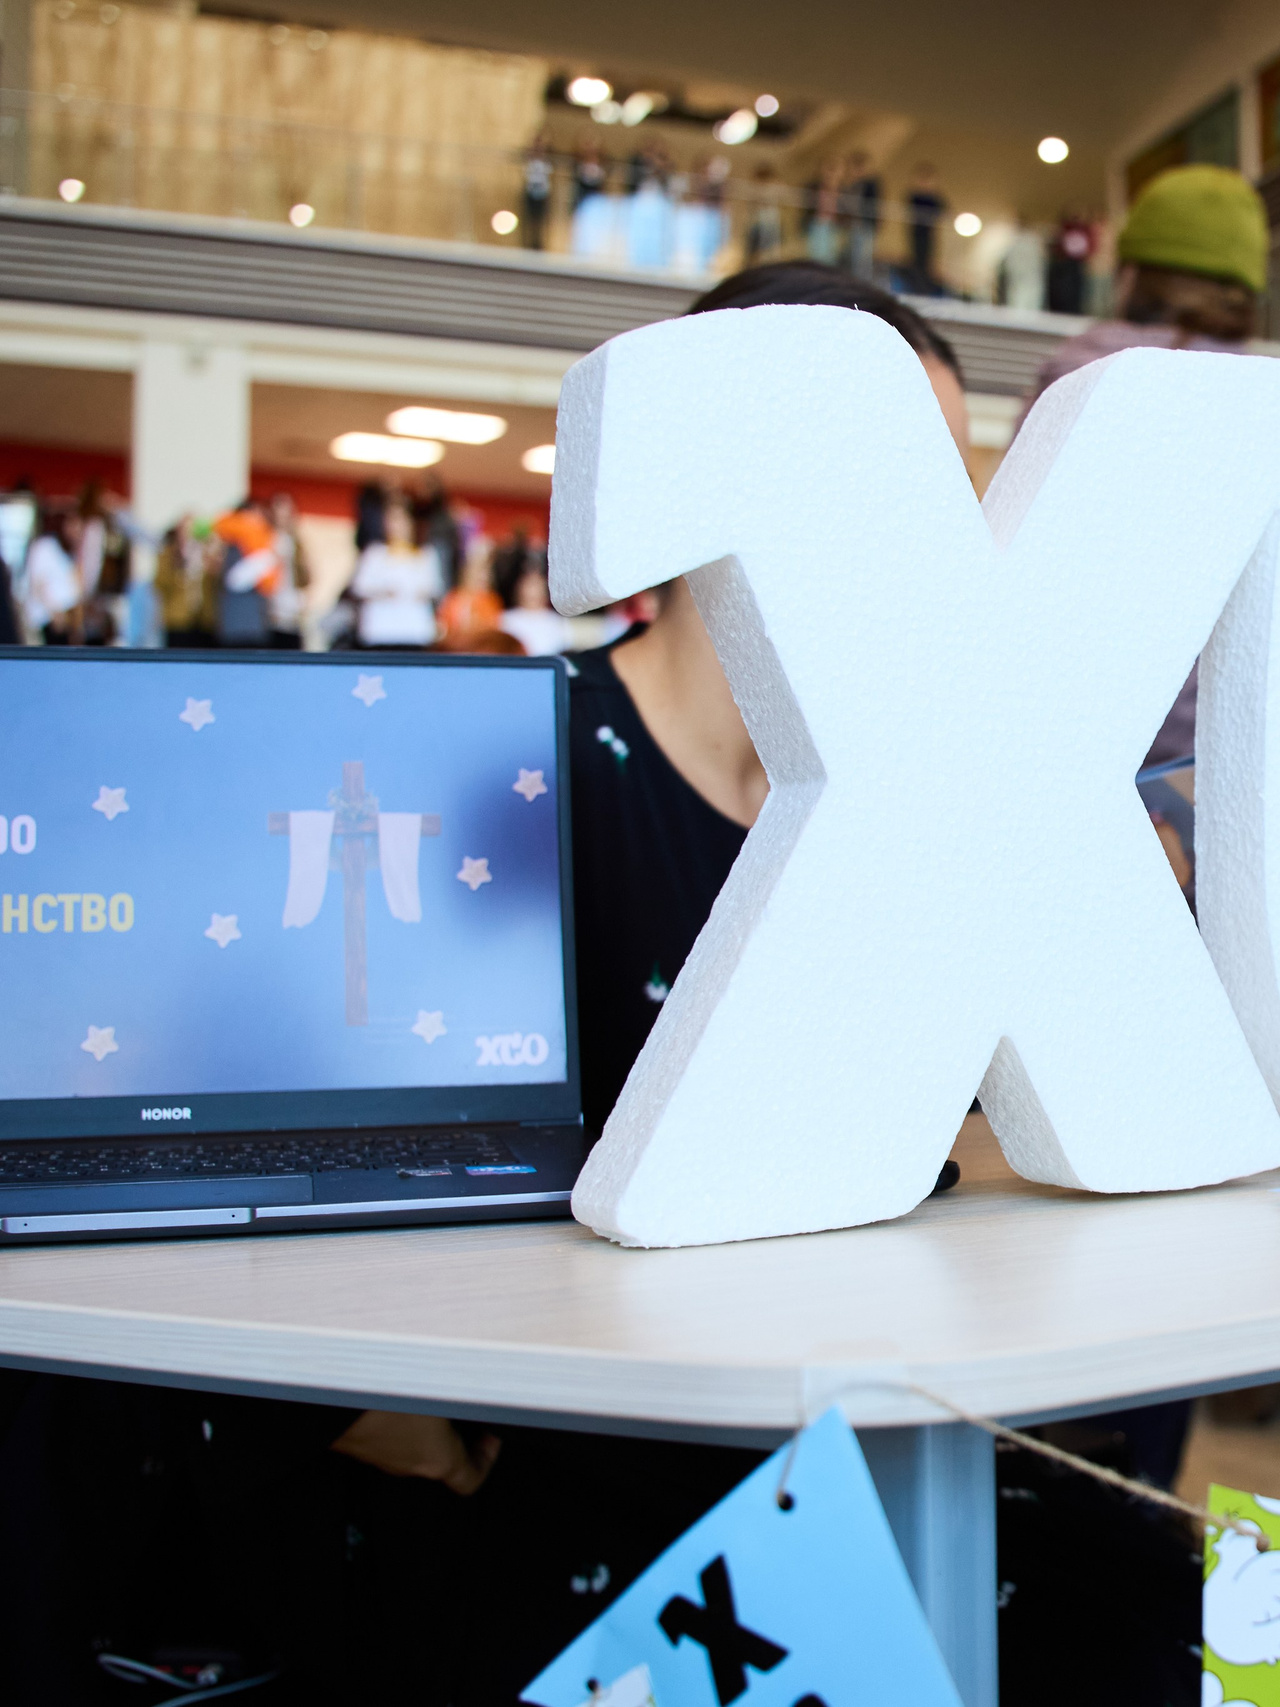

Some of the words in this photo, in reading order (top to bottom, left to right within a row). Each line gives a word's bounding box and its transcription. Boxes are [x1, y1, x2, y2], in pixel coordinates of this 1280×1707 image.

[2, 893, 135, 934] НСТВО
[475, 1030, 549, 1066] ХСО
[141, 1107, 192, 1120] HONOR
[657, 1551, 831, 1707] Х
